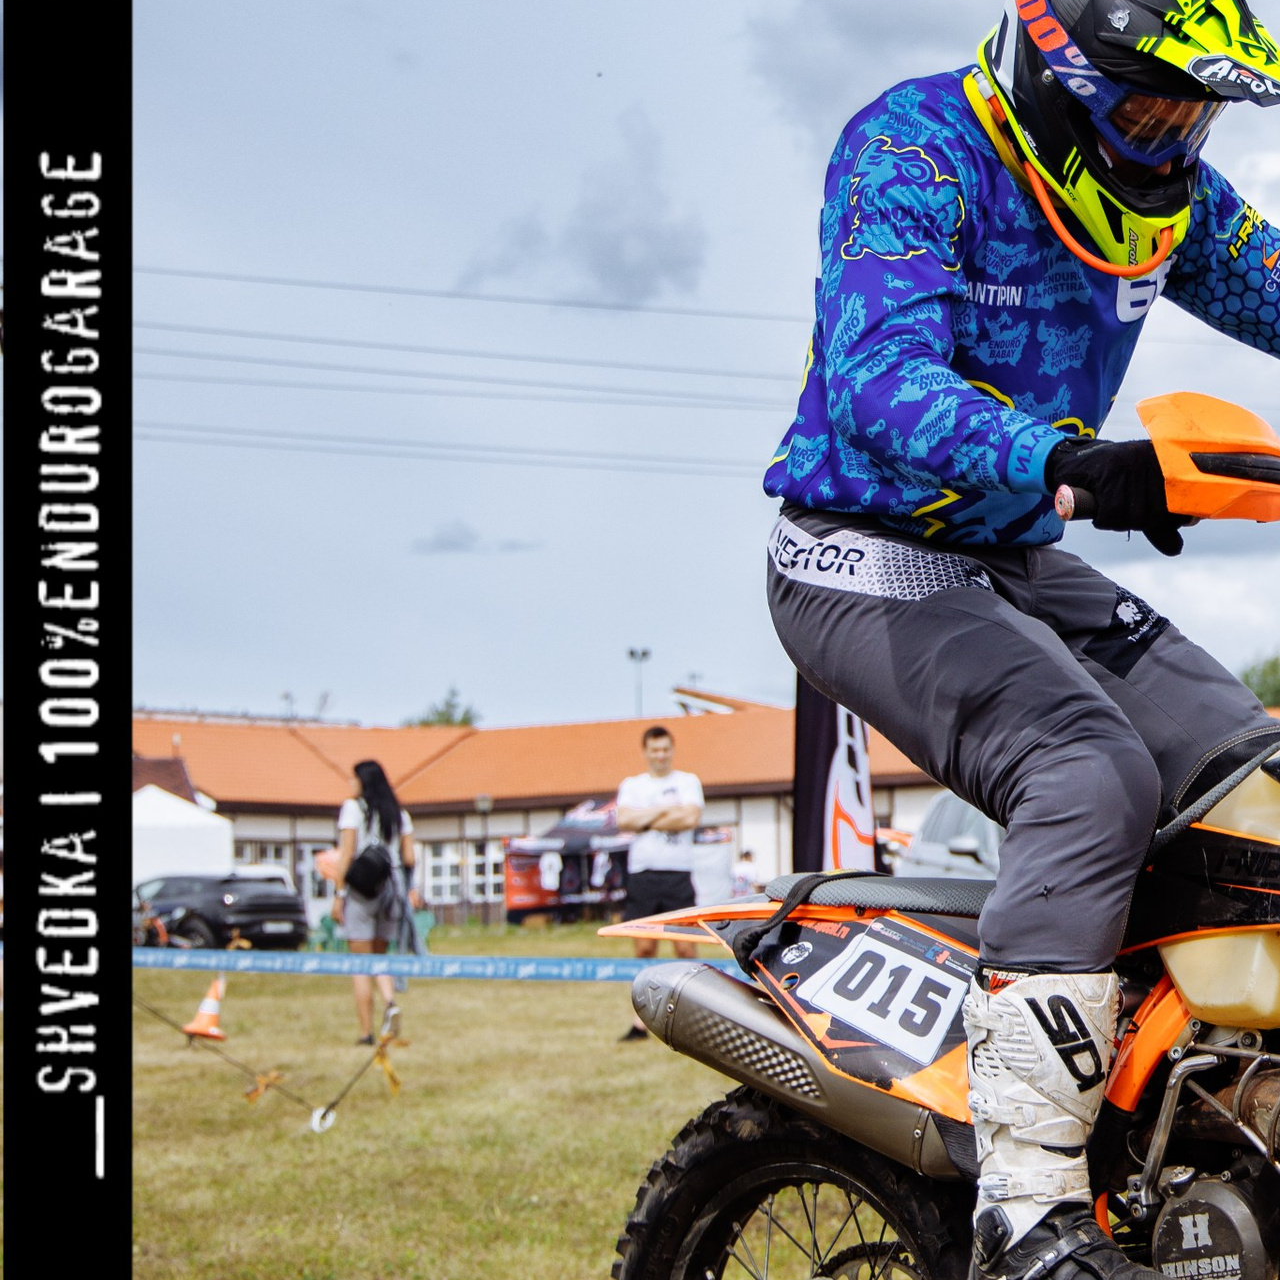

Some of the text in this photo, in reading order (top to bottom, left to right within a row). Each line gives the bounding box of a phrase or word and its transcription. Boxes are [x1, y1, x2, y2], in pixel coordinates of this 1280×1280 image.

[987, 339, 1021, 350] ENDURO
[988, 348, 1017, 359] BABAY
[1051, 344, 1081, 361] ENDURO
[913, 408, 953, 443] ENDURO
[925, 421, 949, 445] UPAL
[832, 950, 952, 1038] 015
[1178, 1212, 1213, 1250] H
[1161, 1253, 1241, 1278] HINSON
